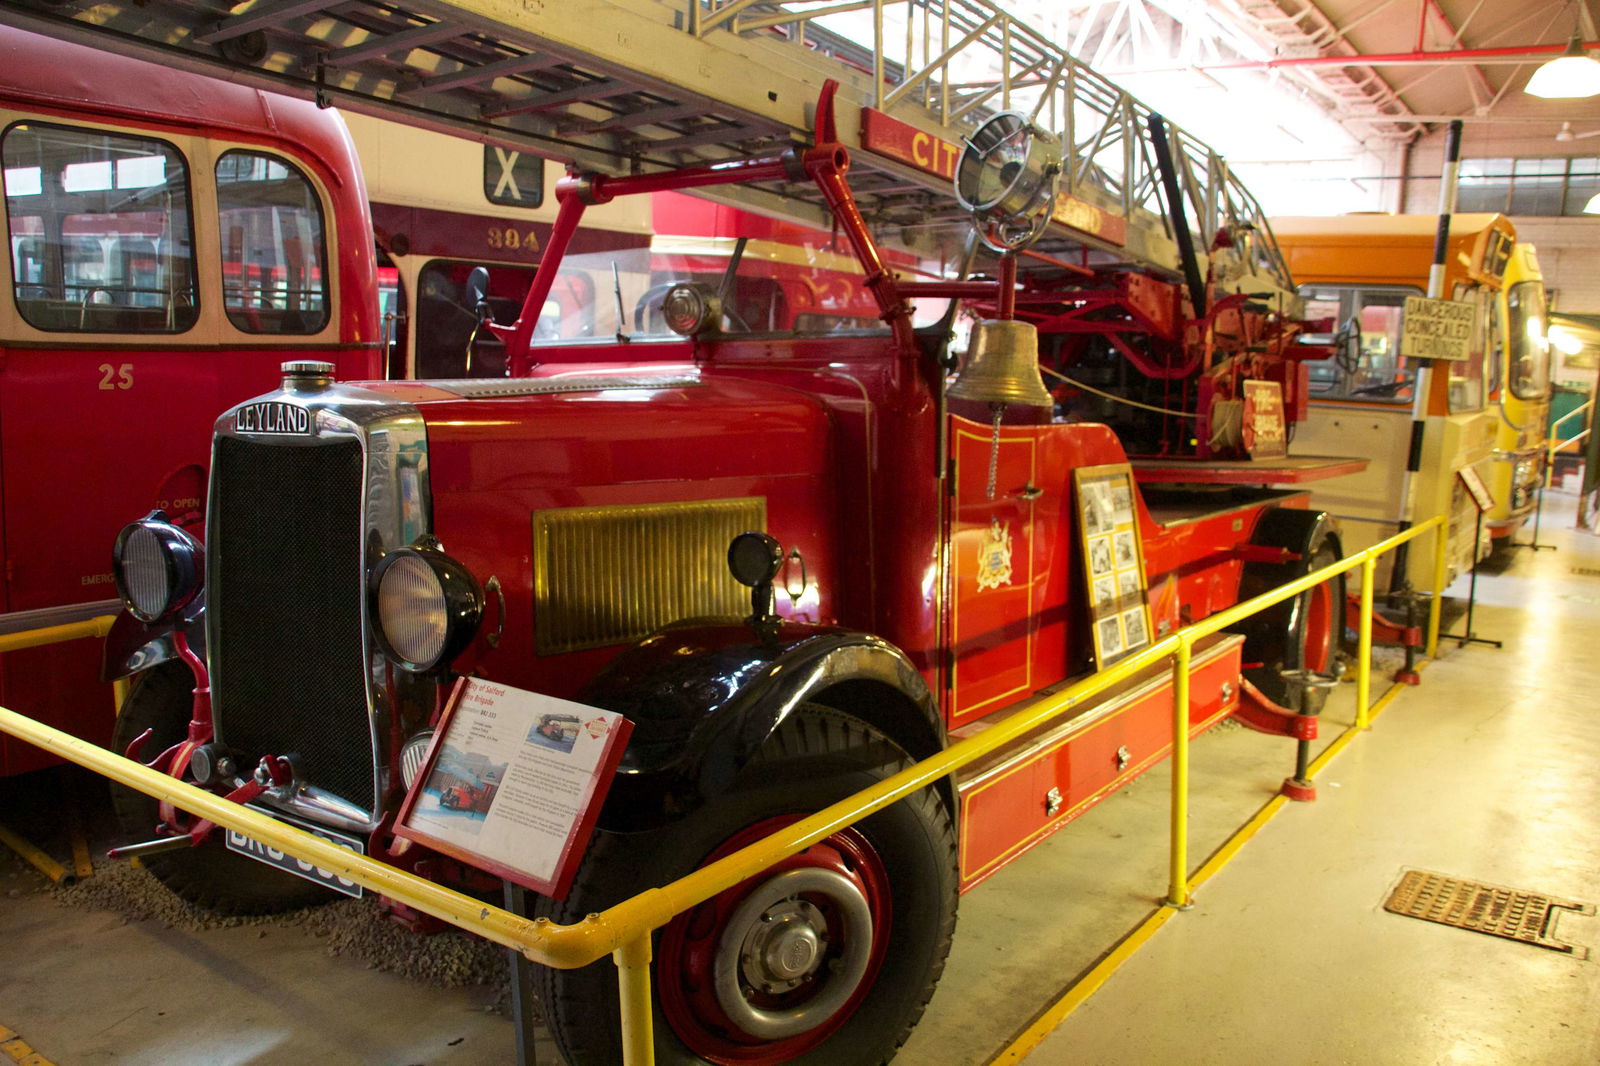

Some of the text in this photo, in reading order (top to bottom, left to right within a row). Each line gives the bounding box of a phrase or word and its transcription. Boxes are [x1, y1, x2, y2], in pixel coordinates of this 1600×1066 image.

[912, 132, 963, 176] CIT
[493, 147, 521, 200] X
[1406, 317, 1471, 340] CONCEALED
[98, 363, 135, 391] 25
[235, 403, 309, 433] LEYLAND
[156, 497, 200, 509] TO OPEN
[475, 694, 494, 705] Brigade
[486, 685, 505, 696] Salford
